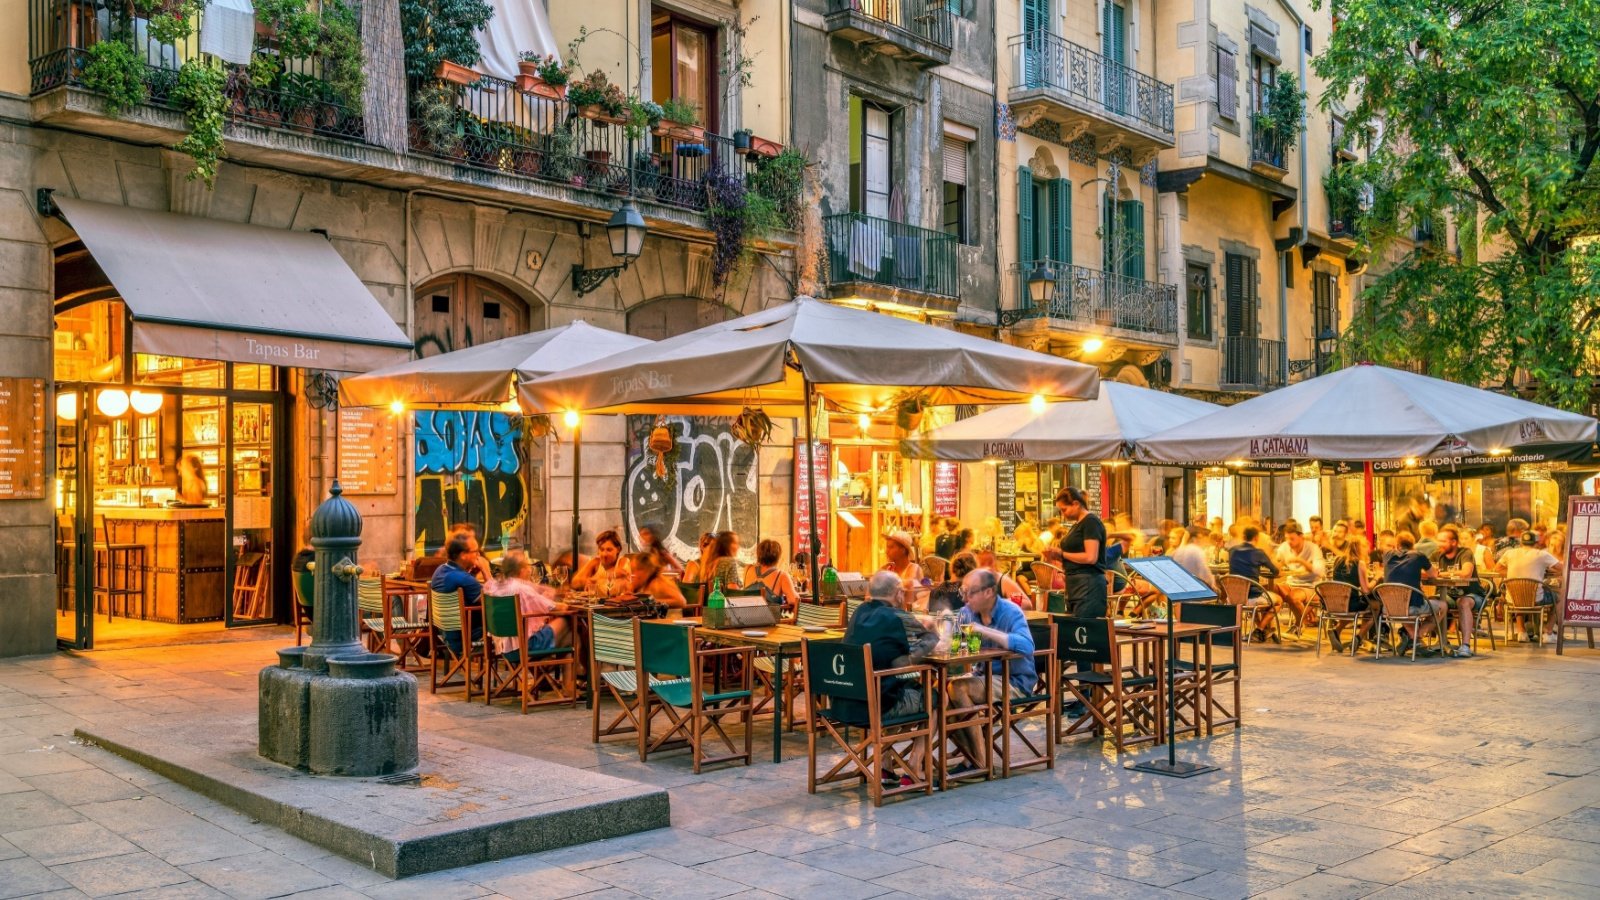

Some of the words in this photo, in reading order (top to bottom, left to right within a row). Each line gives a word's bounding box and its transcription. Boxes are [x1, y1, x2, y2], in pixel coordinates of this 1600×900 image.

[245, 338, 289, 359] Tapas
[294, 343, 320, 359] Bar
[610, 376, 646, 398] Tapas
[648, 370, 673, 389] Bar
[983, 442, 990, 456] LA
[991, 442, 1025, 457] CATALANA
[1250, 440, 1260, 454] LA
[1262, 437, 1309, 454] CATALANA
[1465, 455, 1506, 464] restaurant
[1508, 453, 1545, 462] vinateria
[1578, 503, 1587, 514] LA
[1075, 626, 1088, 645] G
[832, 653, 845, 676] G
